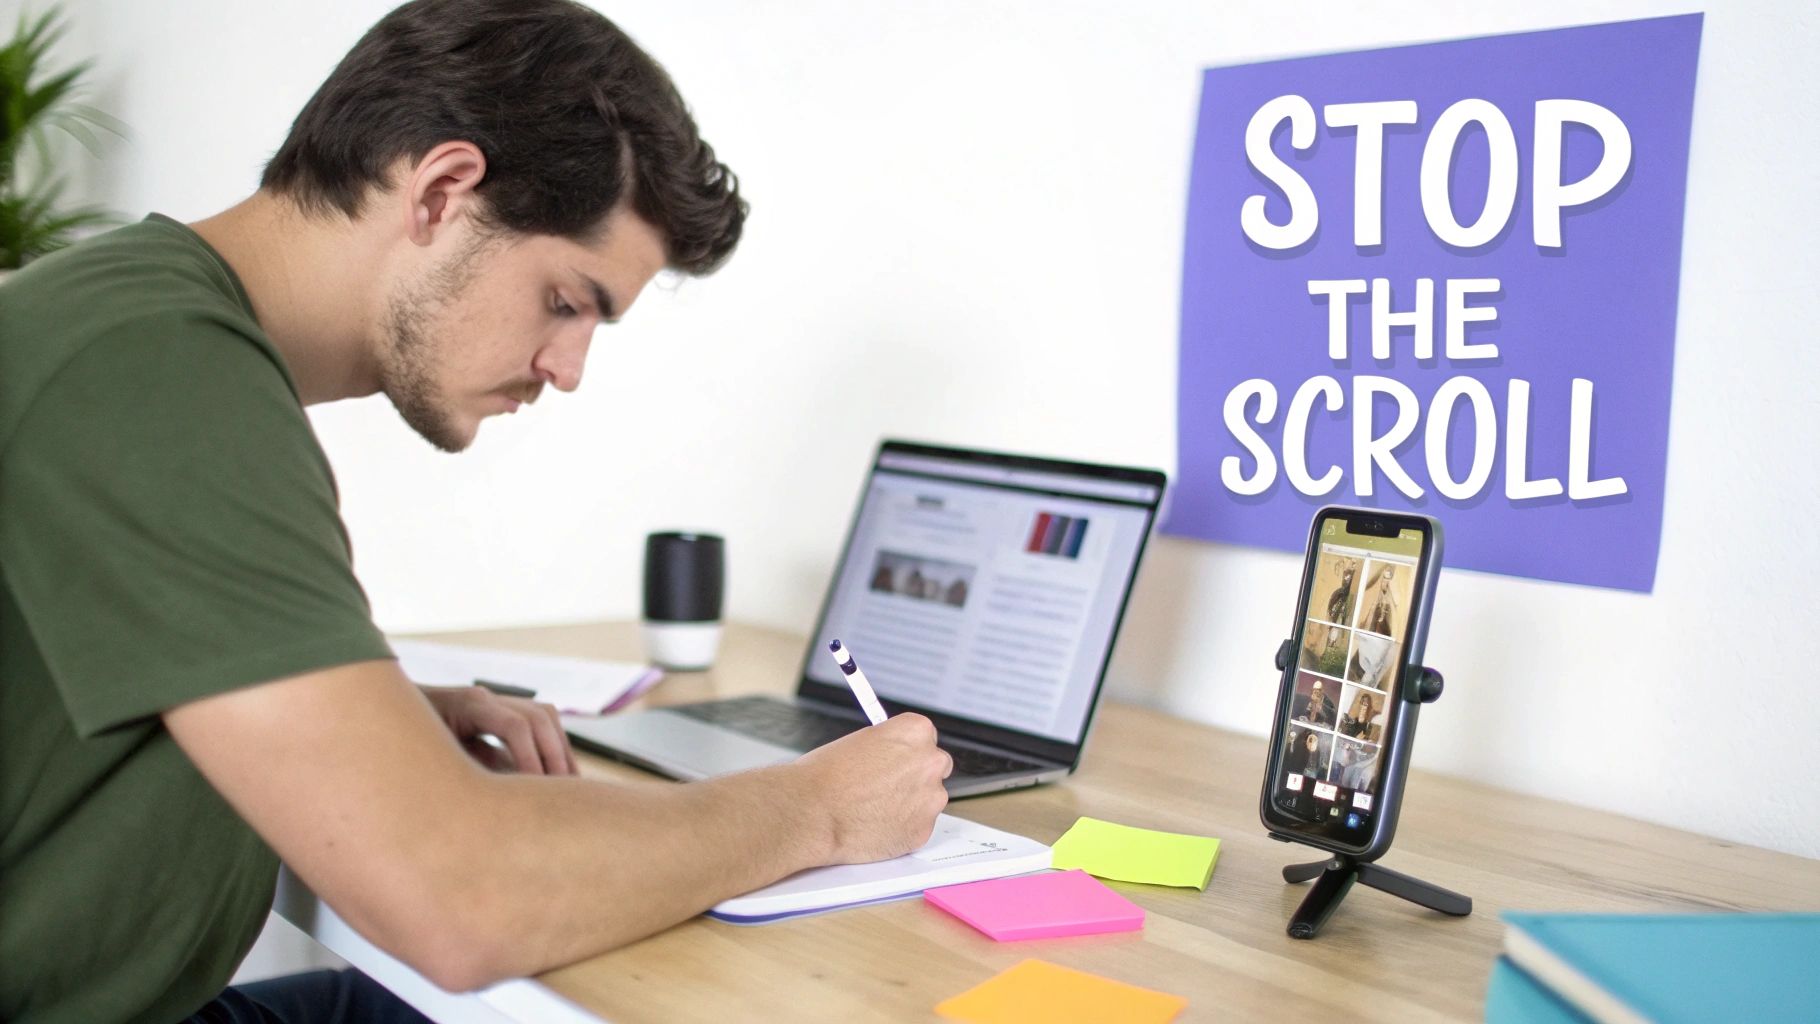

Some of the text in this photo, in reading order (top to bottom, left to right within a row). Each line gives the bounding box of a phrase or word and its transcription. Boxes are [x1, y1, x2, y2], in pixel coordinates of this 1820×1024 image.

[1241, 95, 1632, 250] STOP
[1308, 278, 1501, 360] THE
[1221, 375, 1628, 500] SCROLL
